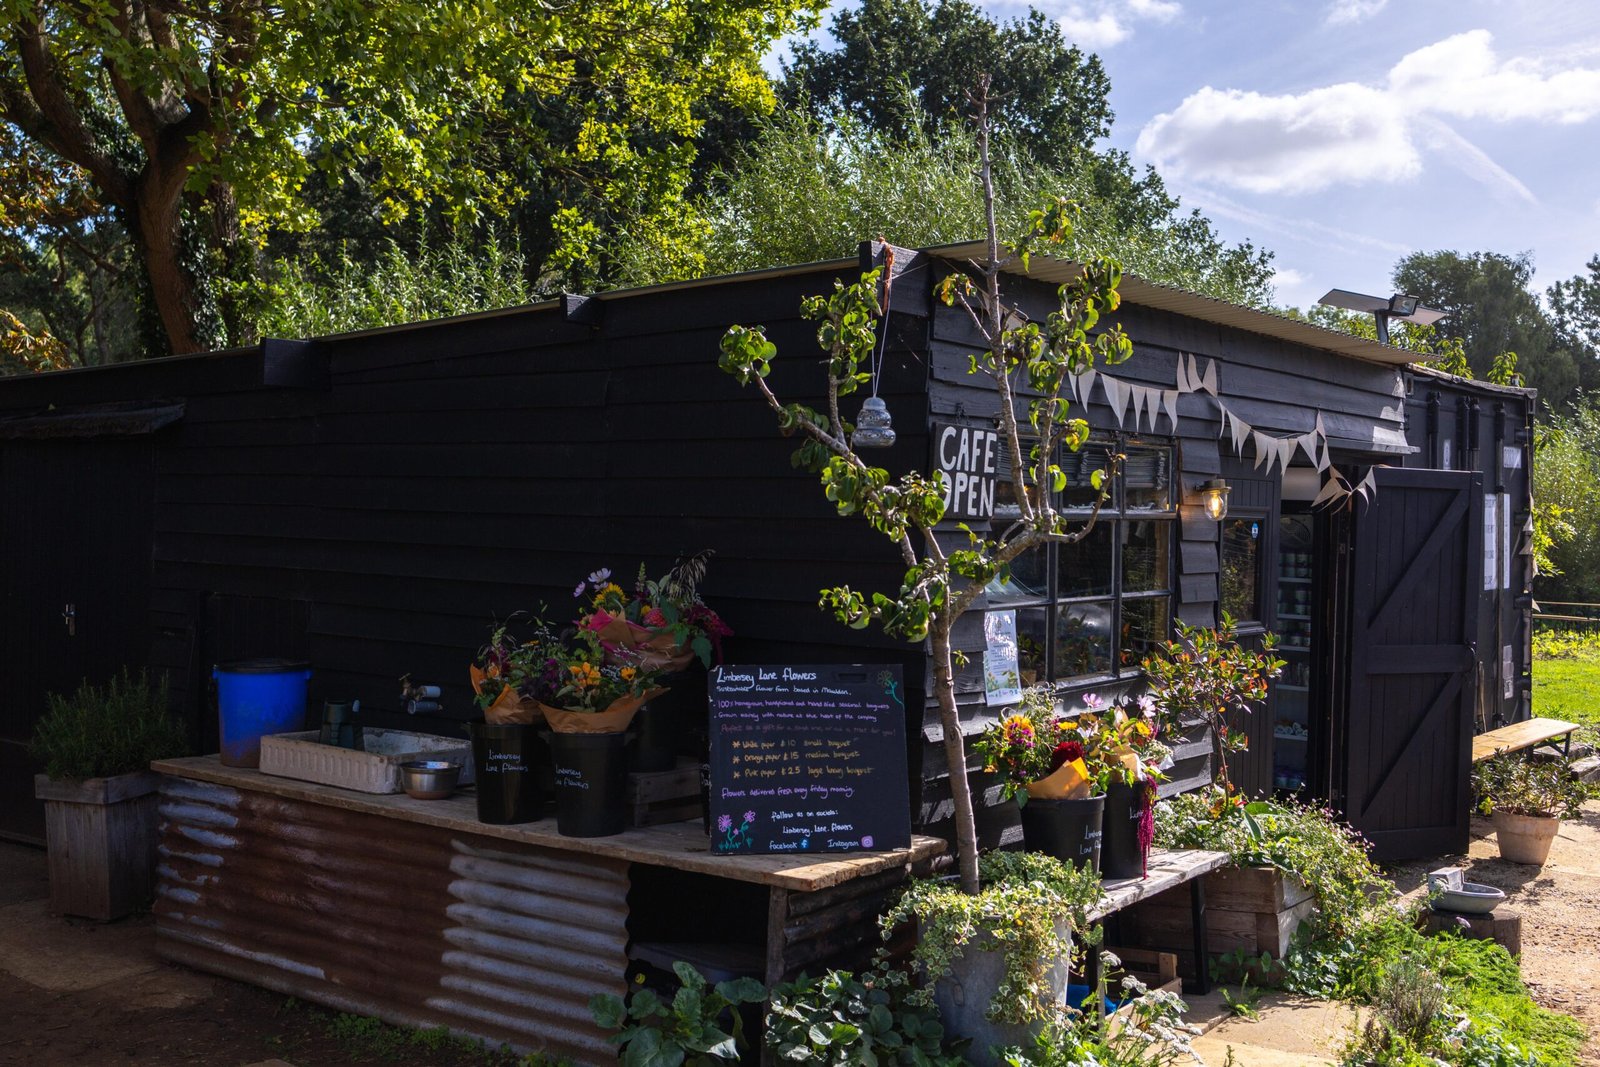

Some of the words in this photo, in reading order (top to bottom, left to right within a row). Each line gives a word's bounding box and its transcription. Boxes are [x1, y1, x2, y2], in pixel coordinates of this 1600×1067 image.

[940, 426, 997, 473] CAFE
[717, 667, 754, 688] Limbersey
[759, 668, 777, 680] Lane
[793, 685, 810, 693] based
